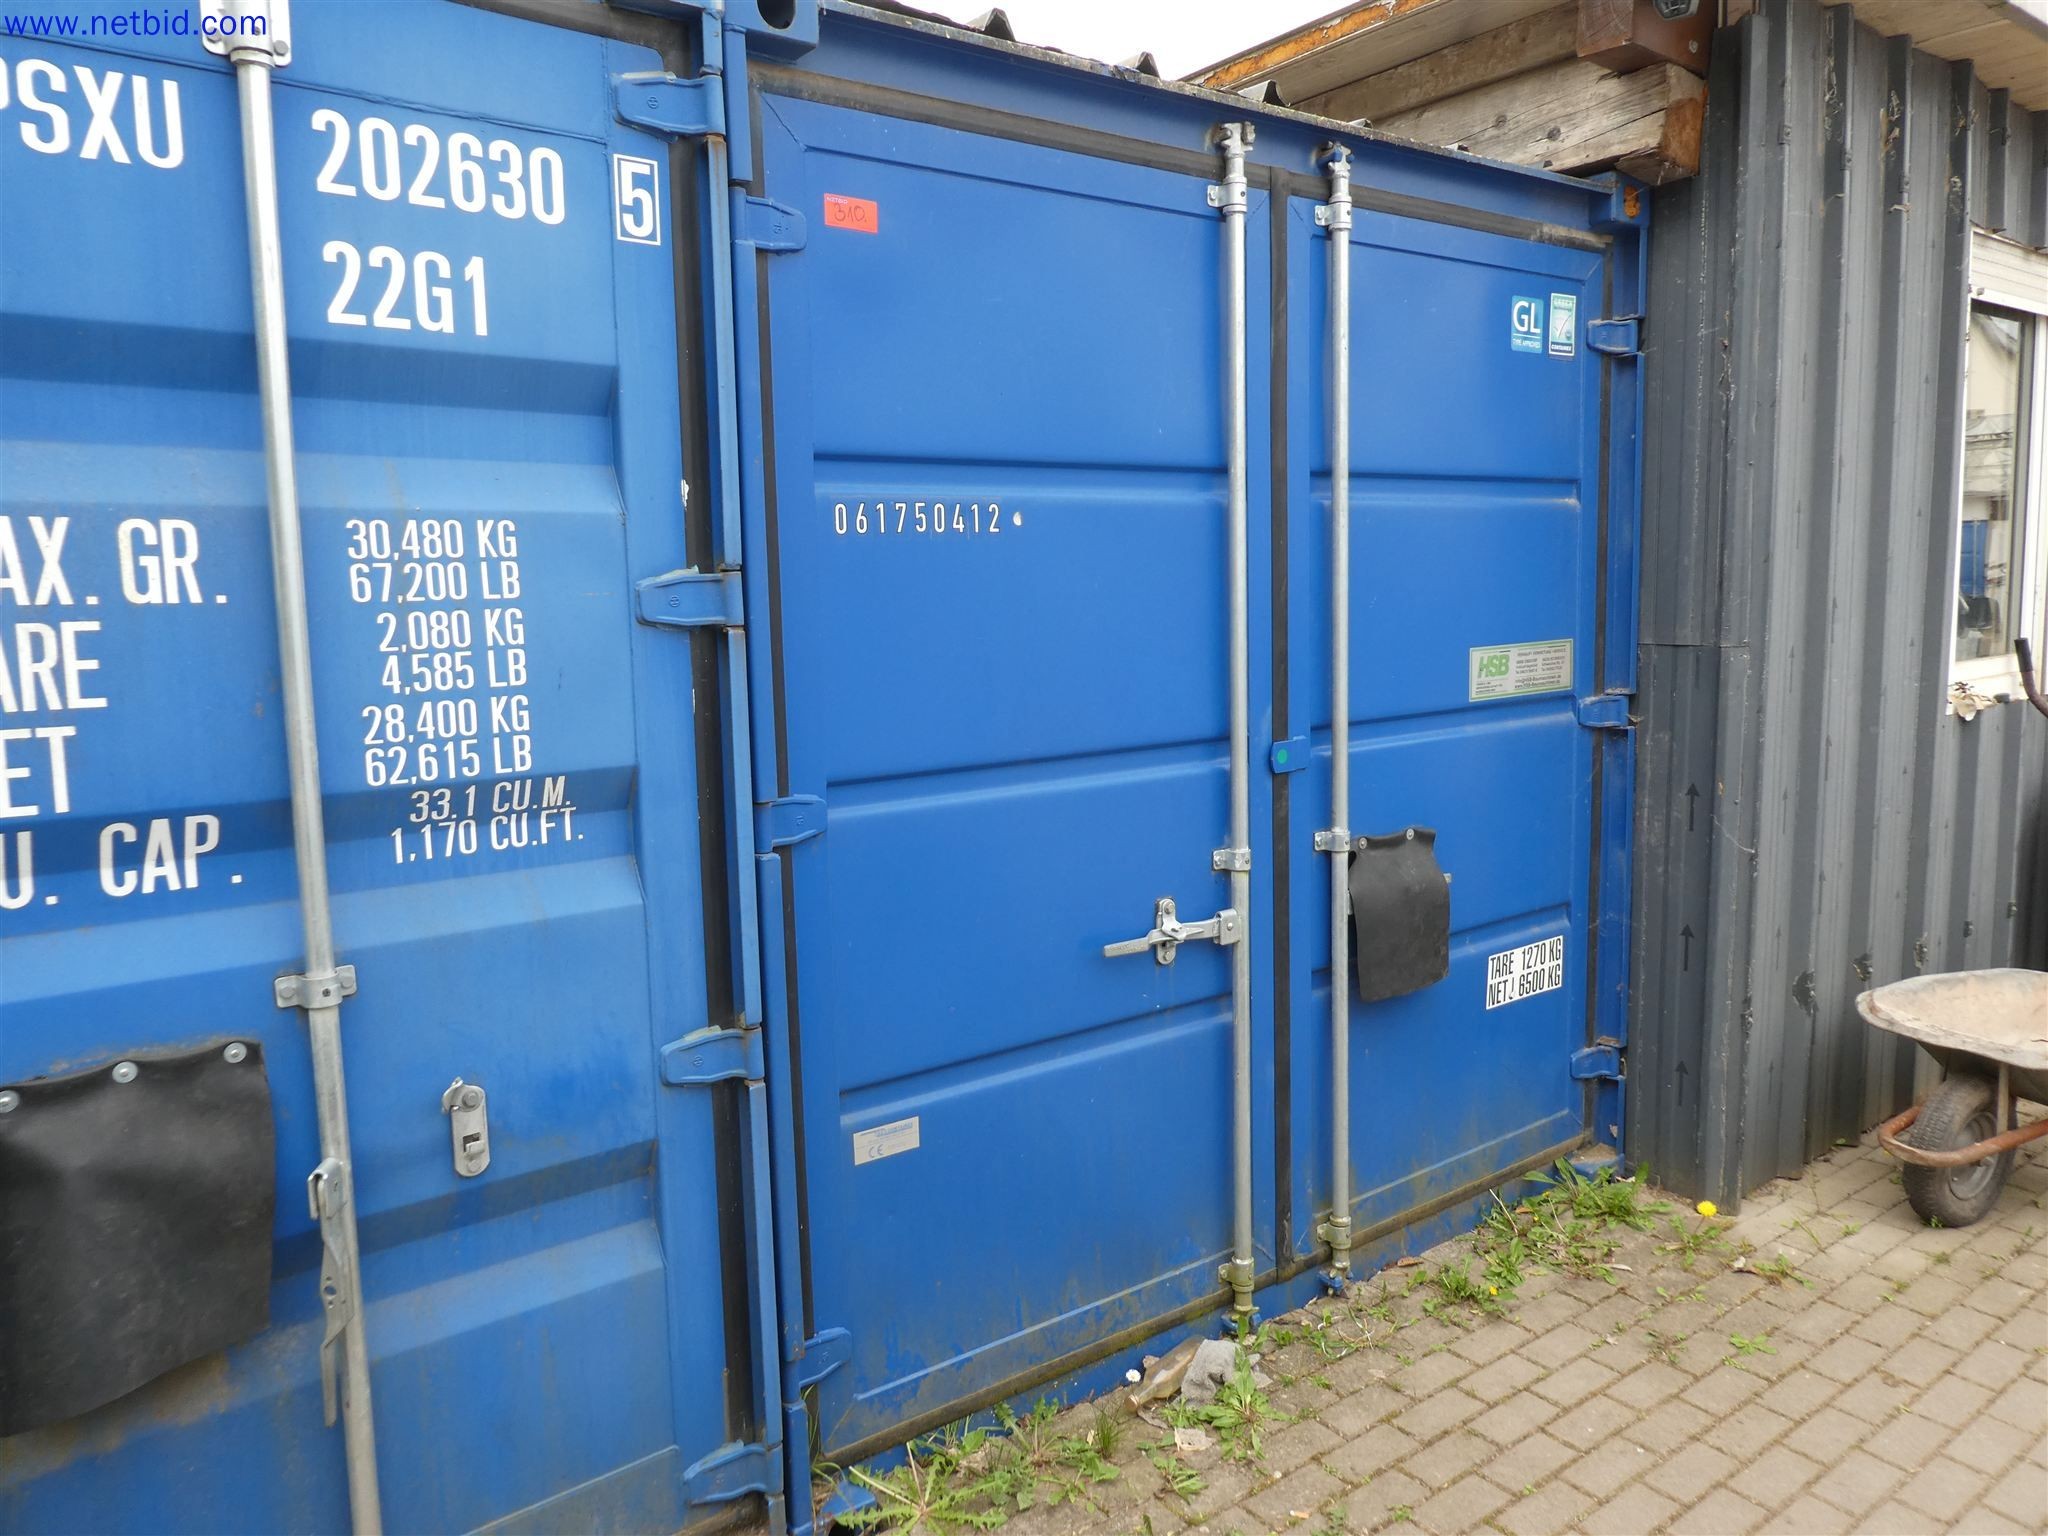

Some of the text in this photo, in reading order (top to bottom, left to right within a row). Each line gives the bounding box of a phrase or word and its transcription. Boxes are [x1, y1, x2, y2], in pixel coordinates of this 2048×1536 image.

[0, 56, 653, 238] SXU 202630 5
[322, 240, 488, 336] 22G1
[1513, 300, 1541, 334] GL
[345, 519, 518, 560] 30,480 KG
[834, 502, 1000, 535] 061750412
[118, 518, 228, 604] GR.
[350, 561, 521, 603] 67,200 LB
[376, 608, 525, 653] 2,080 KG
[382, 648, 527, 695] 4,585 LB
[1477, 653, 1510, 679] HSB
[361, 695, 530, 745] 28,400 KG
[0, 726, 76, 818] ET
[365, 734, 532, 786] 62,615 LB
[409, 775, 571, 822] 33.1 CU.M.
[99, 814, 242, 897] CAP.
[390, 806, 584, 864] 1,170 CU.FT.
[1490, 938, 1561, 980] TARE 1270 KG
[1519, 968, 1545, 996] 6500
[1548, 963, 1560, 988] KG
